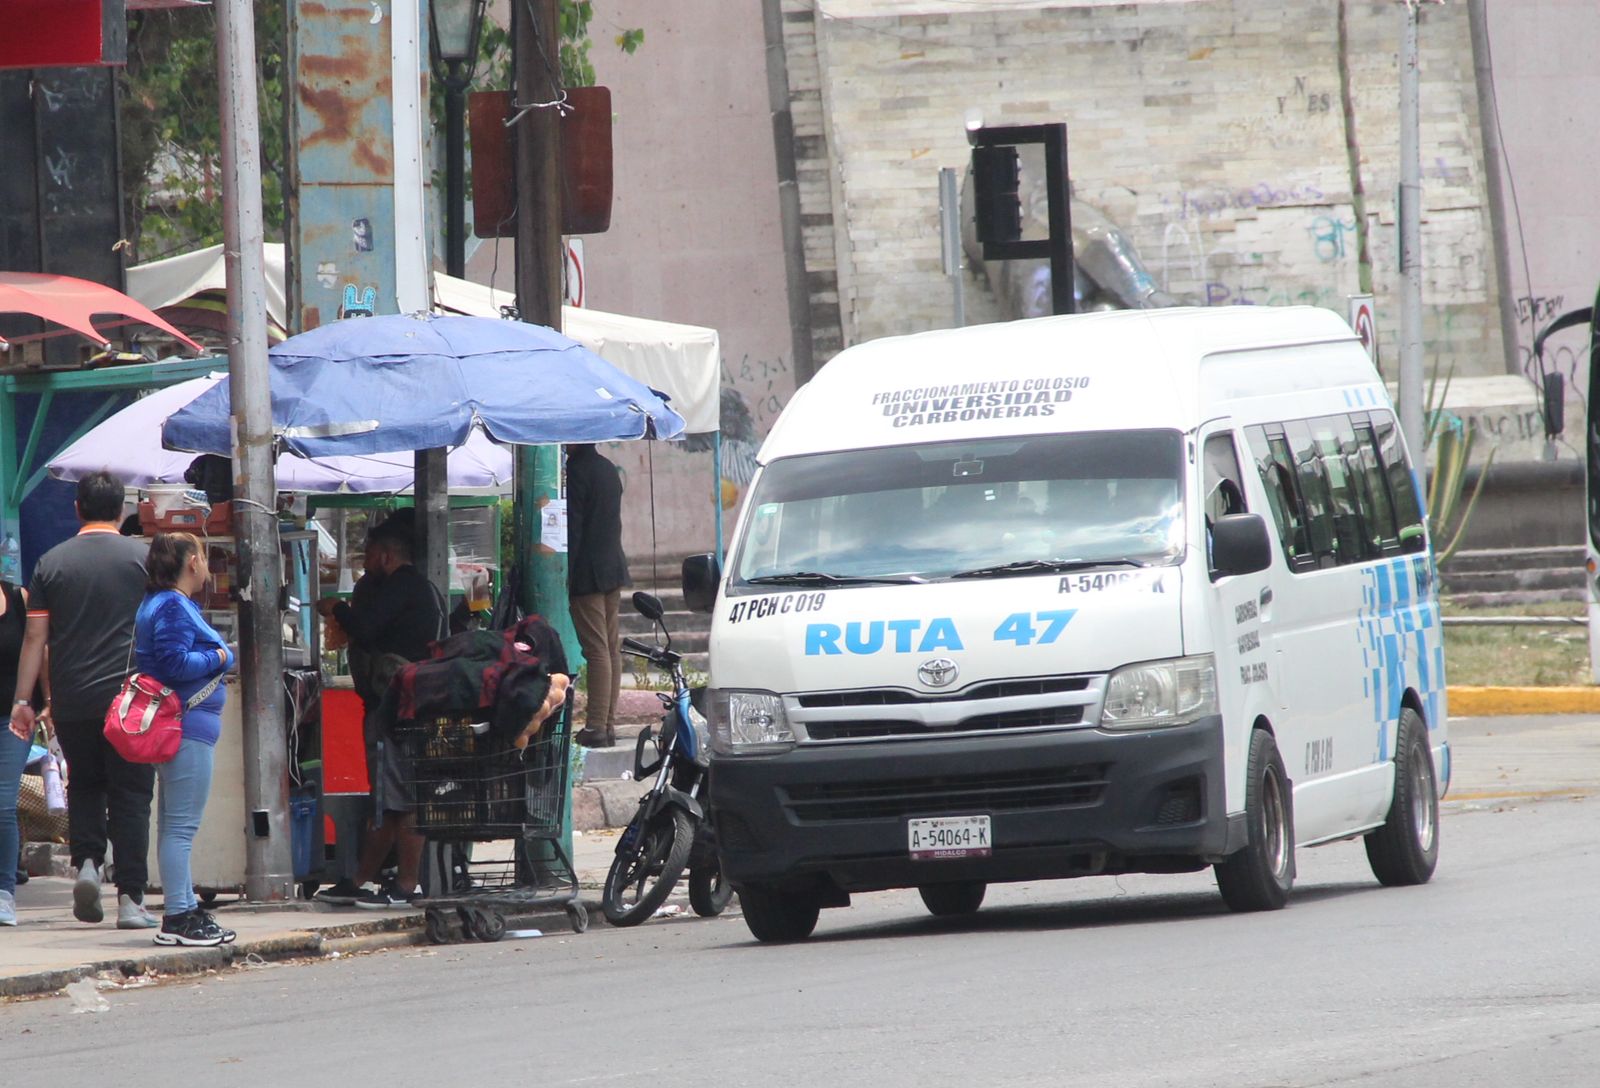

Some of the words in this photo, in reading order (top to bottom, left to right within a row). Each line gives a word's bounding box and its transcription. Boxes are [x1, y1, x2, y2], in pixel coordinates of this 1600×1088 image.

[872, 380, 1019, 405] FRACCIONAMIENTO
[1022, 376, 1091, 392] COLOSIO
[882, 390, 1073, 416] UNIVERSIDAD
[892, 404, 1056, 428] CARBONERAS
[728, 602, 747, 624] 47
[747, 596, 779, 621] PCH
[781, 594, 794, 614] C
[795, 593, 826, 613] 019
[805, 618, 964, 656] RUTA
[993, 609, 1079, 646] 47
[912, 827, 987, 848] A-54064-K
